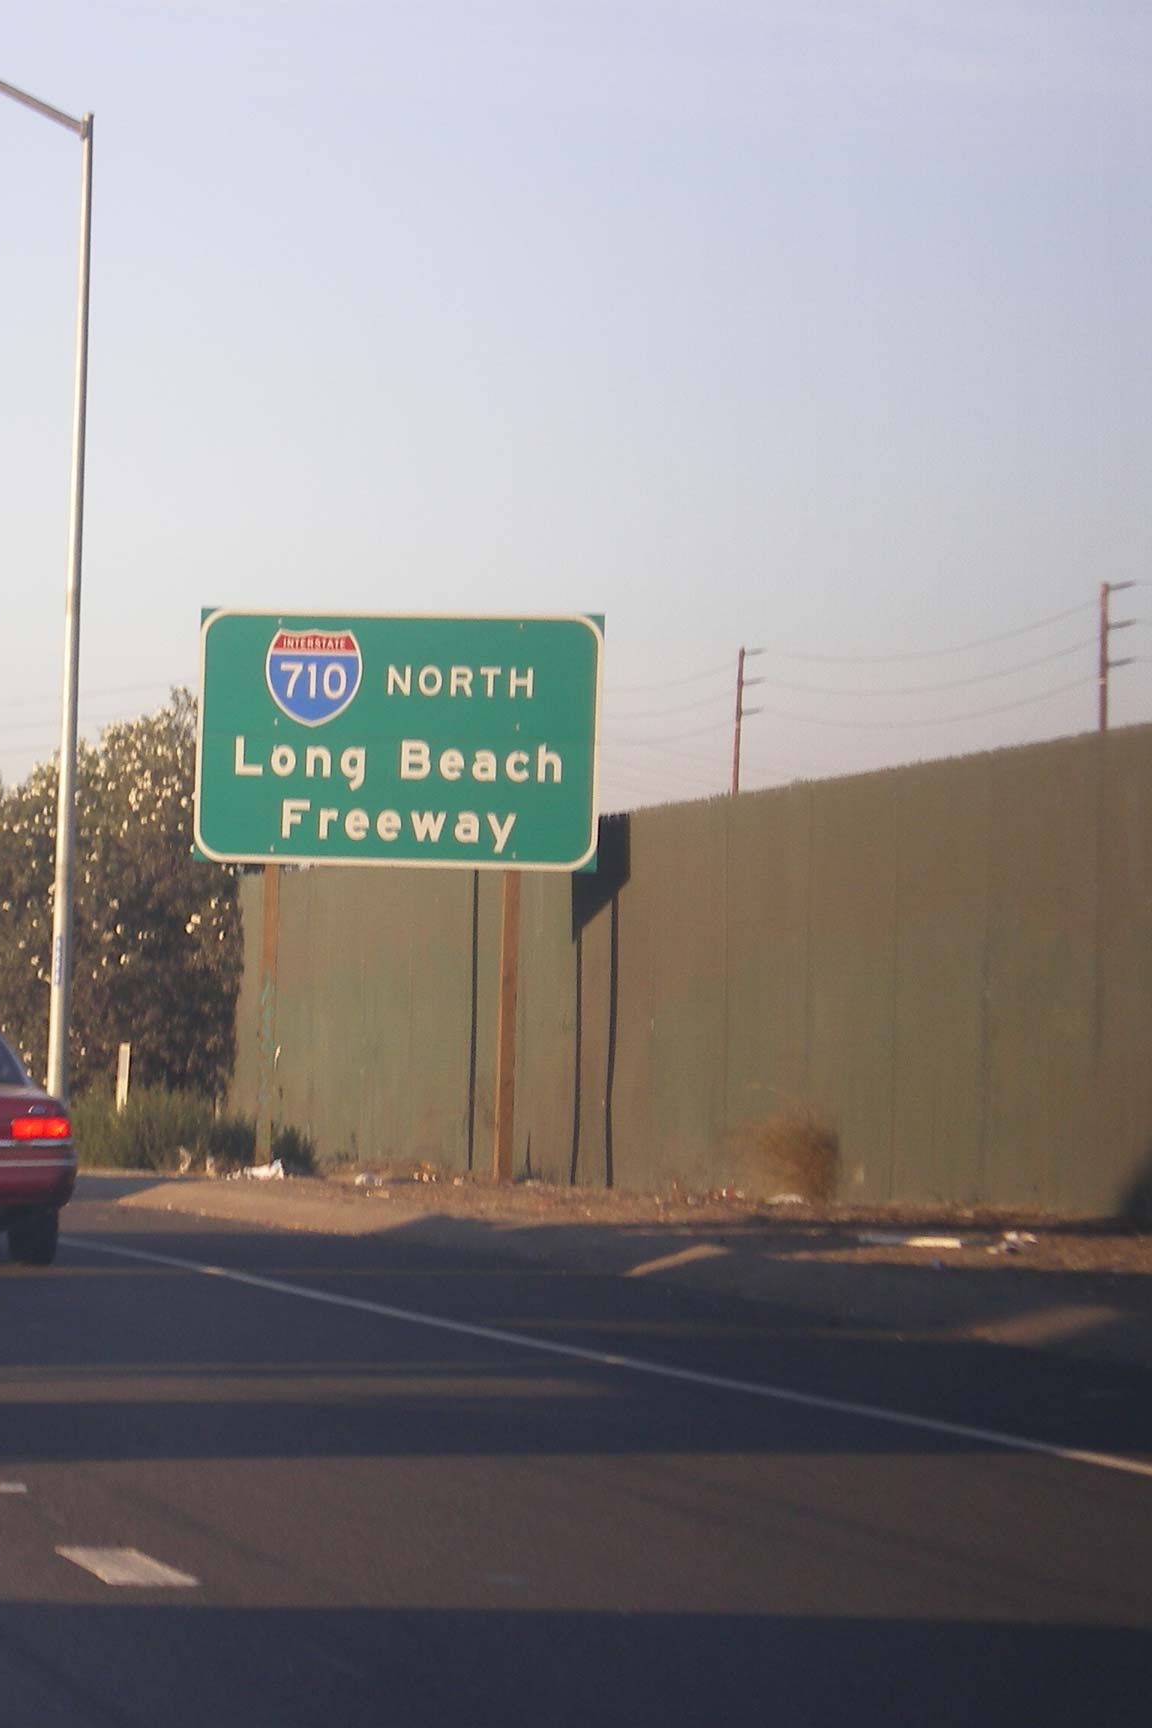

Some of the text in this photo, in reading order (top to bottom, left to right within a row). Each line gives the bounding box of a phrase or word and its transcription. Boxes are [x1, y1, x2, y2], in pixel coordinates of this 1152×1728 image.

[282, 637, 347, 651] INTERSTATE
[280, 661, 348, 700] 710
[386, 664, 535, 699] NORTH
[234, 735, 563, 792] Long Beach
[280, 798, 517, 854] Freeway
